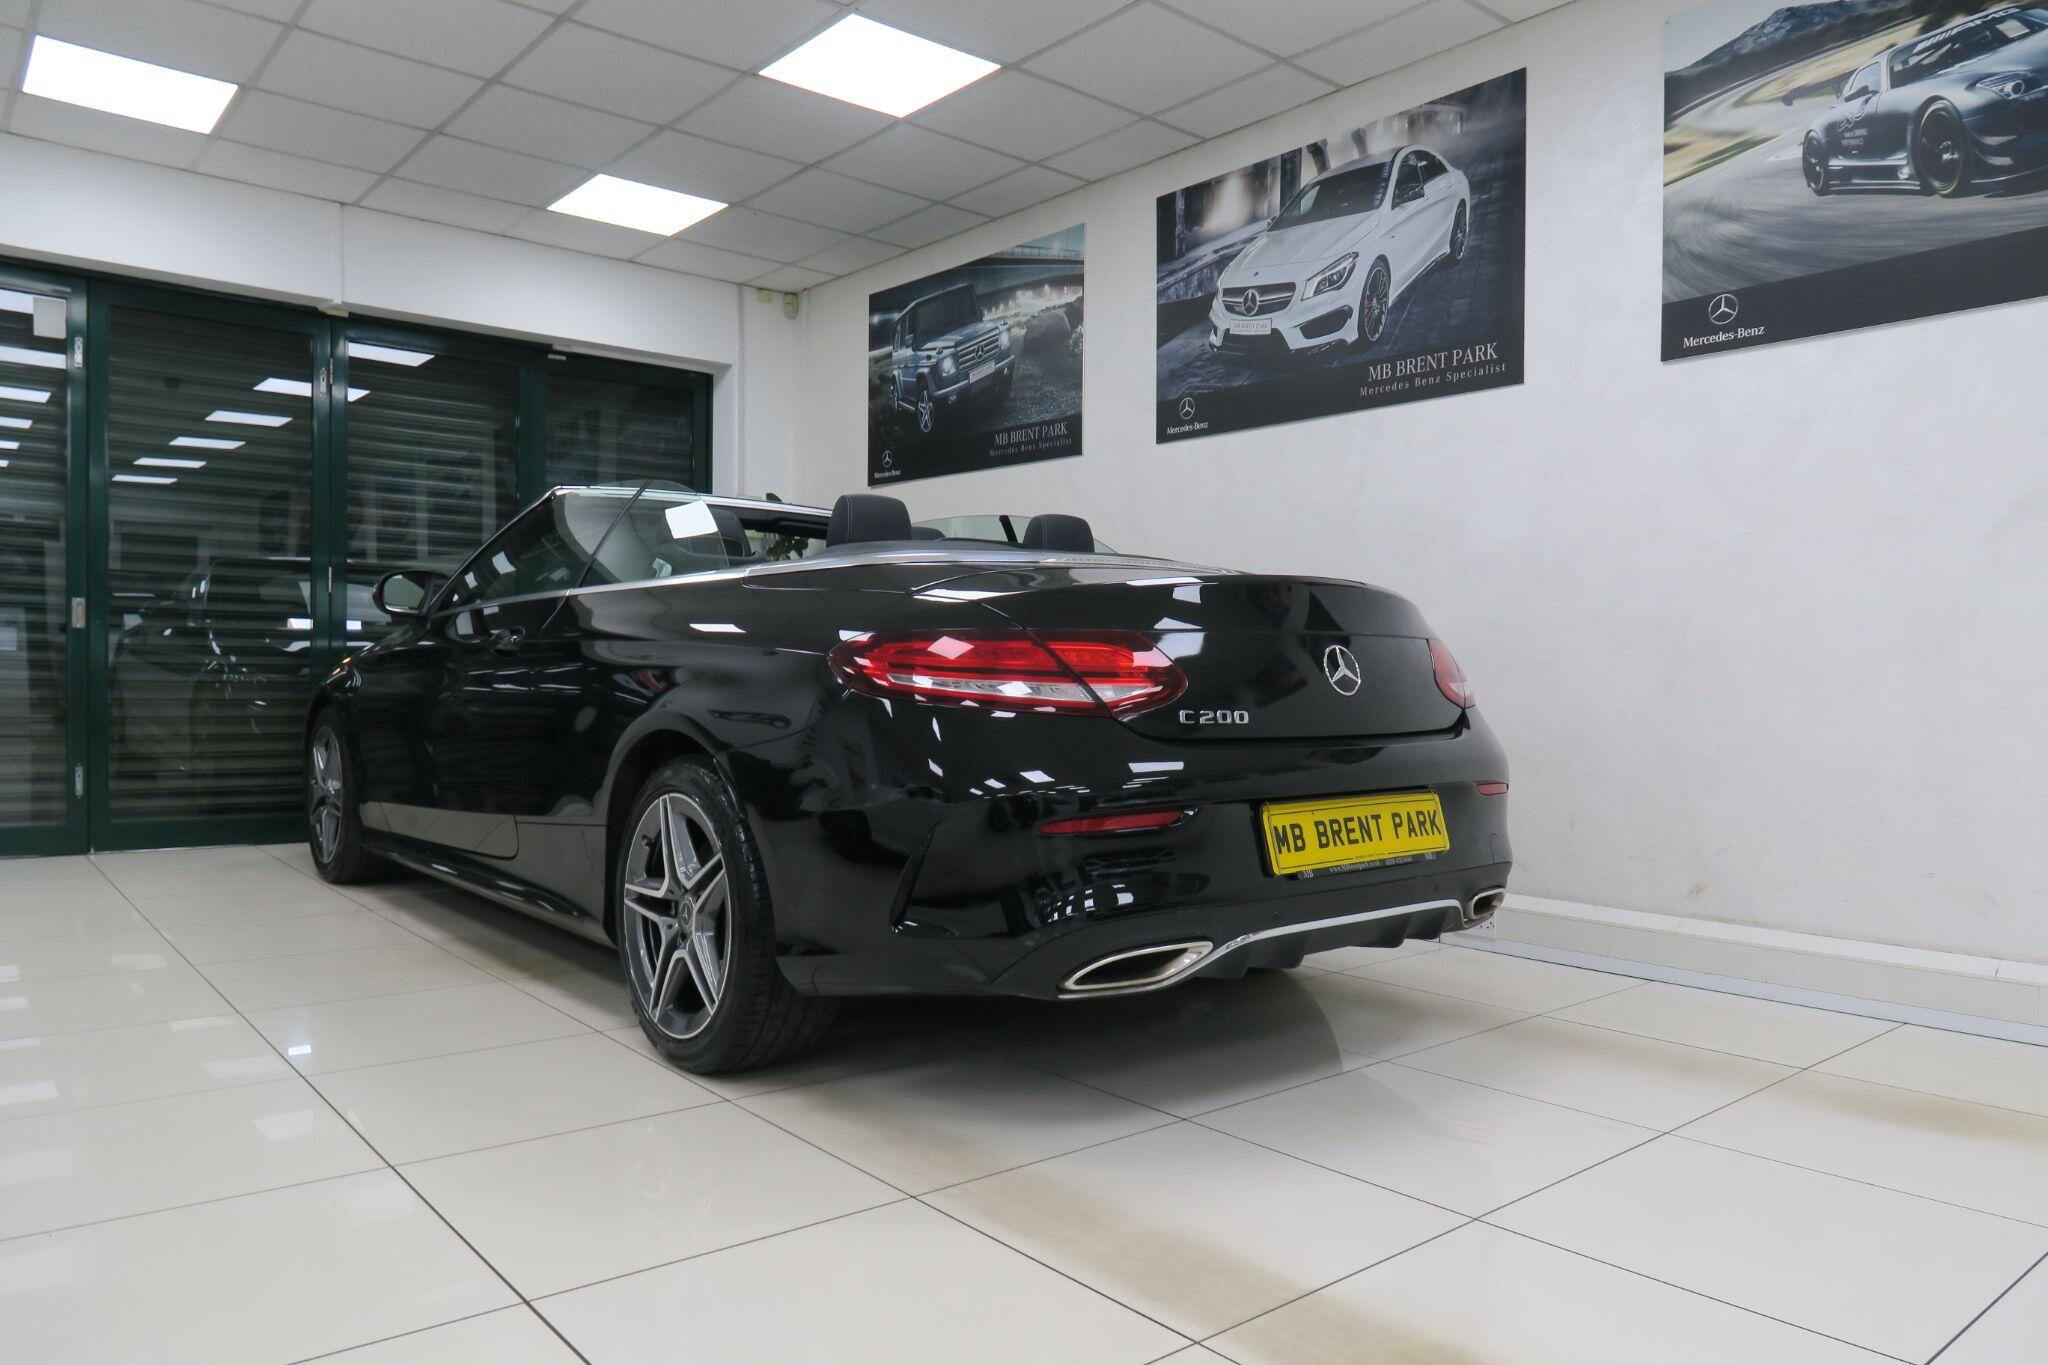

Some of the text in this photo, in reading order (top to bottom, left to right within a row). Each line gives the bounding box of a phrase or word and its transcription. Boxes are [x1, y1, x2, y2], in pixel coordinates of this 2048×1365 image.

[1683, 326, 1765, 348] Mercedes-Benz
[1368, 342, 1499, 381] MB BRENT PARK
[1360, 363, 1506, 396] Mercedes Benz Specialist
[995, 421, 1067, 446] MB BRENT PARK
[1166, 421, 1208, 435] Mercedes-Benz
[1273, 810, 1442, 854] MB BRENT PARK
